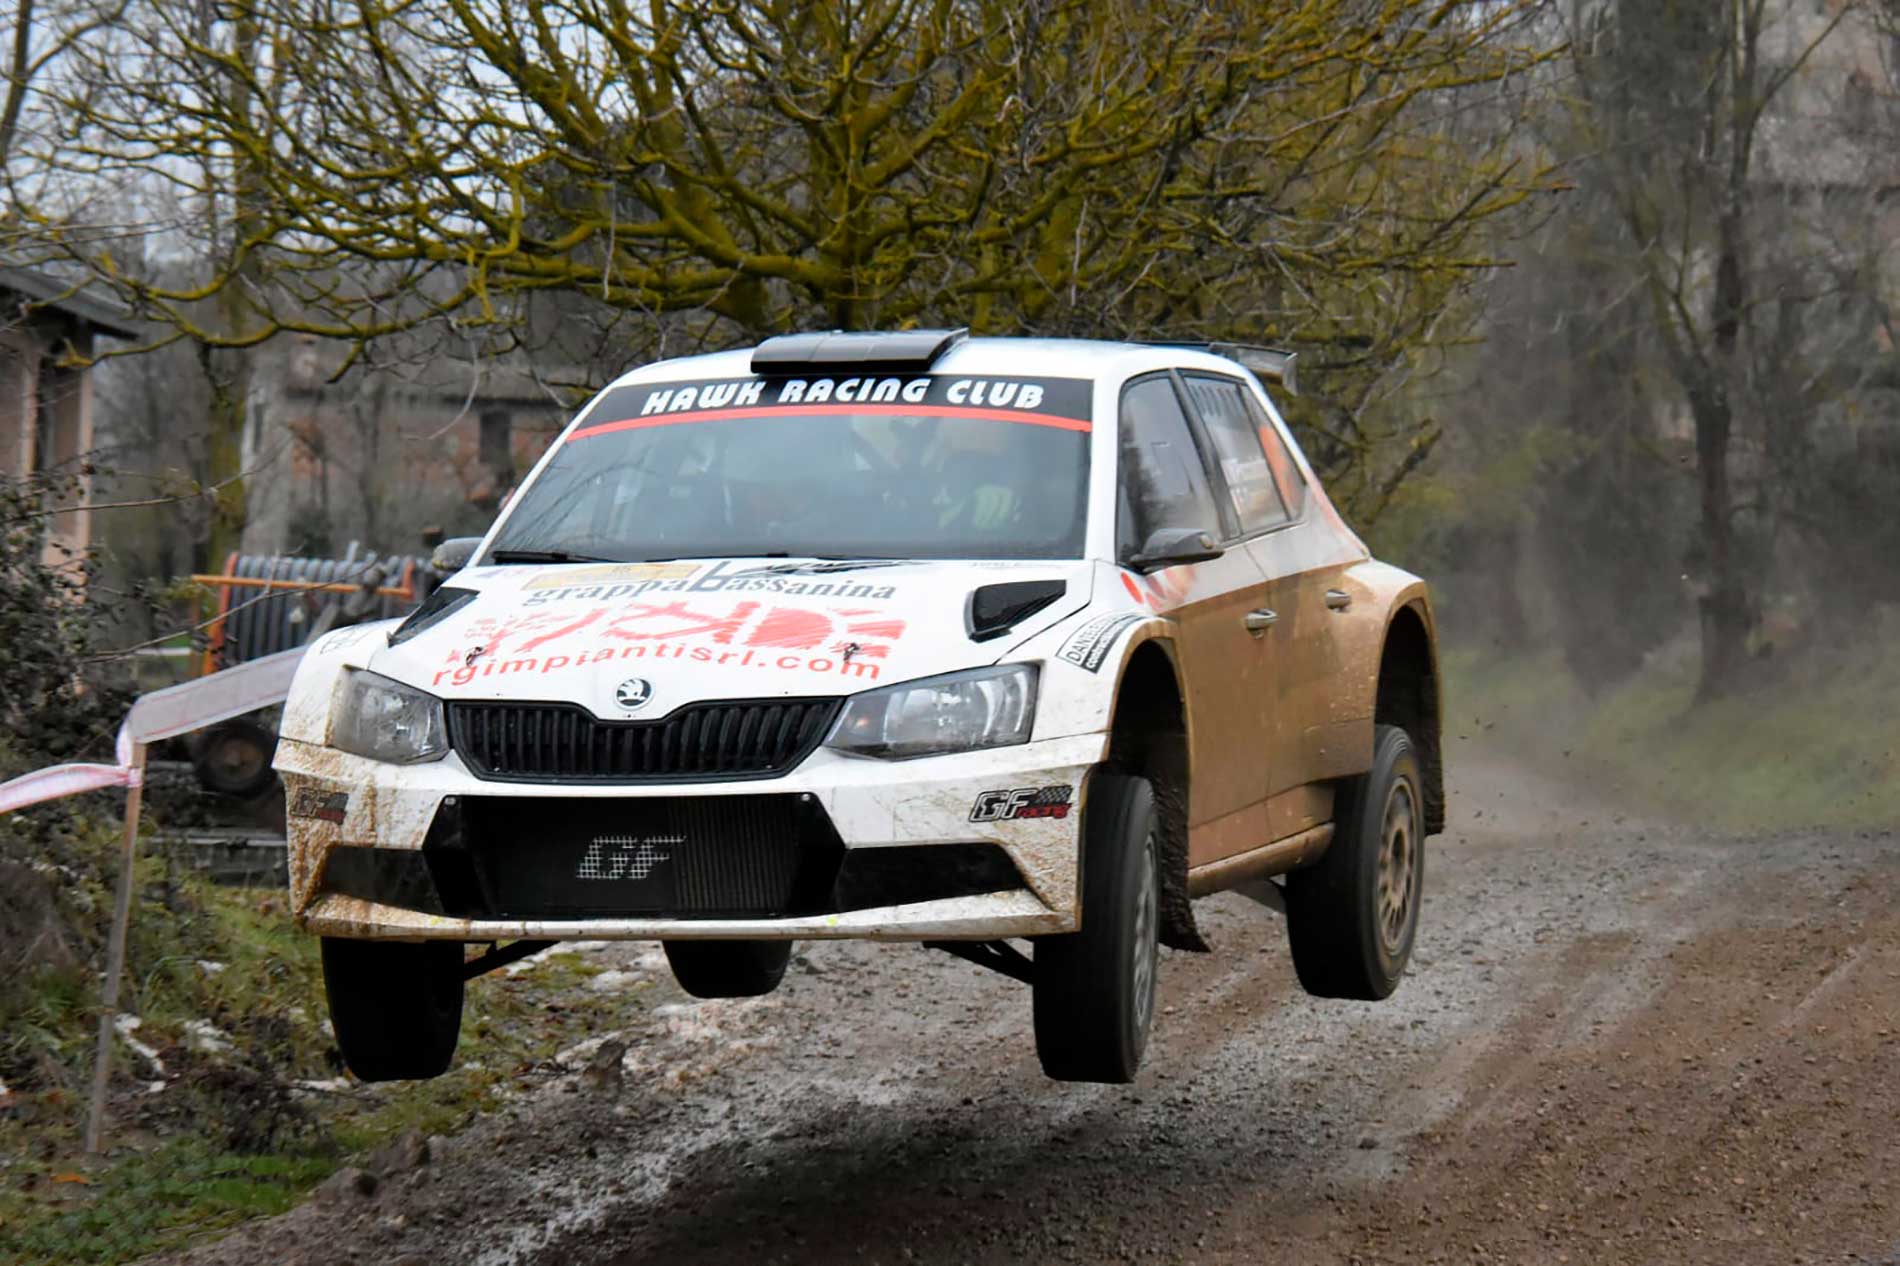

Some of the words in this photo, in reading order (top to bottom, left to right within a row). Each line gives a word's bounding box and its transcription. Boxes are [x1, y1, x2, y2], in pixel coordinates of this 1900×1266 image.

[640, 381, 767, 416] HAWK
[777, 378, 931, 404] RACING
[946, 379, 1044, 409] CLUB
[432, 642, 880, 686] rgimpiantisrl.com
[968, 788, 1038, 822] GF
[576, 835, 687, 879] GF
